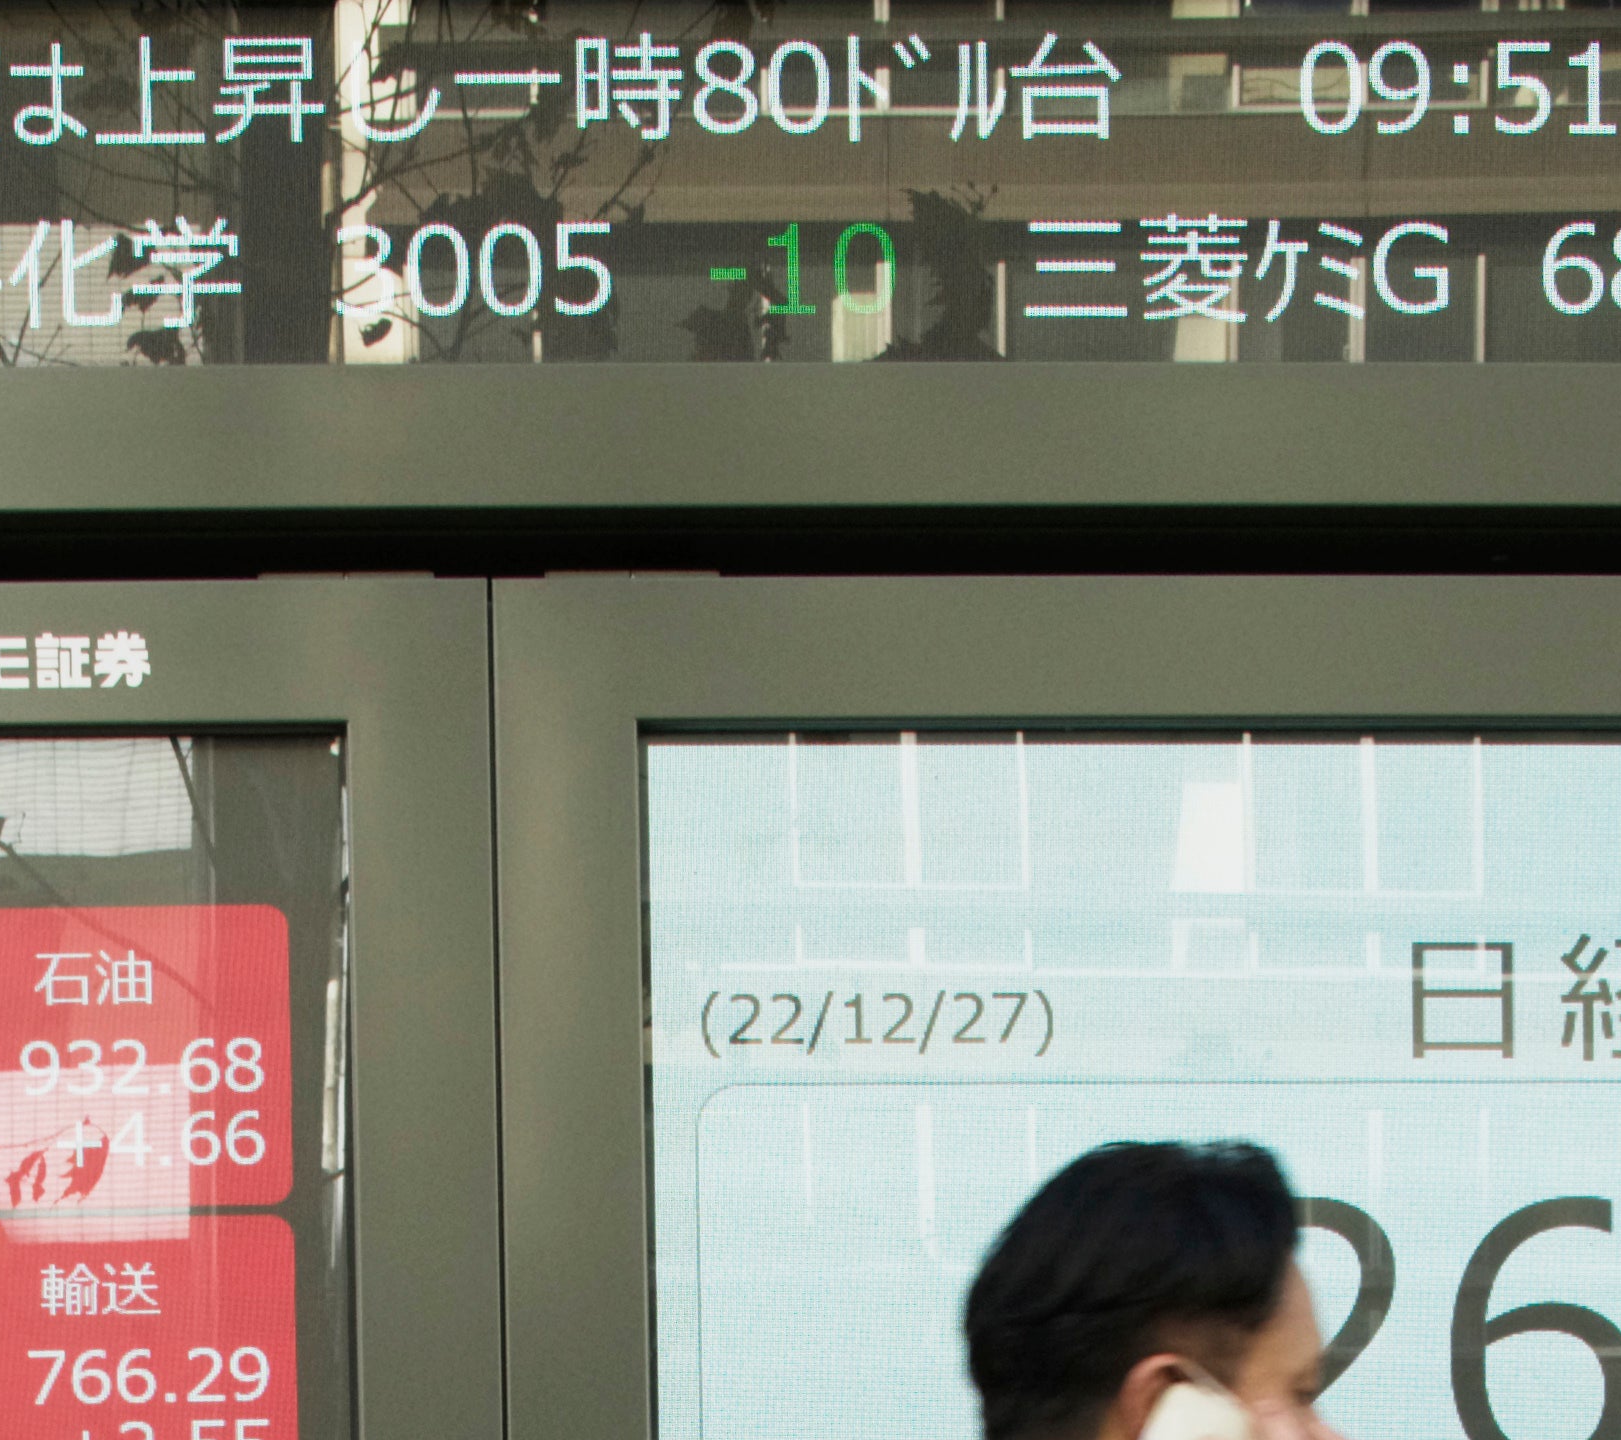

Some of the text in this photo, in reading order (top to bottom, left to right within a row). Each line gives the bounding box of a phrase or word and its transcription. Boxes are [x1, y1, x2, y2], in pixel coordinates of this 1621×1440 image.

[1299, 40, 1617, 136] 09:51
[335, 222, 612, 317] 3005
[709, 222, 896, 316] -10
[33, 949, 154, 1007] 石油
[699, 988, 1055, 1058] (22/12/27)
[18, 1036, 265, 1096] 932.68
[57, 1109, 267, 1169] +4.66
[39, 1261, 162, 1317] 輸送
[26, 1346, 272, 1406] 766.29
